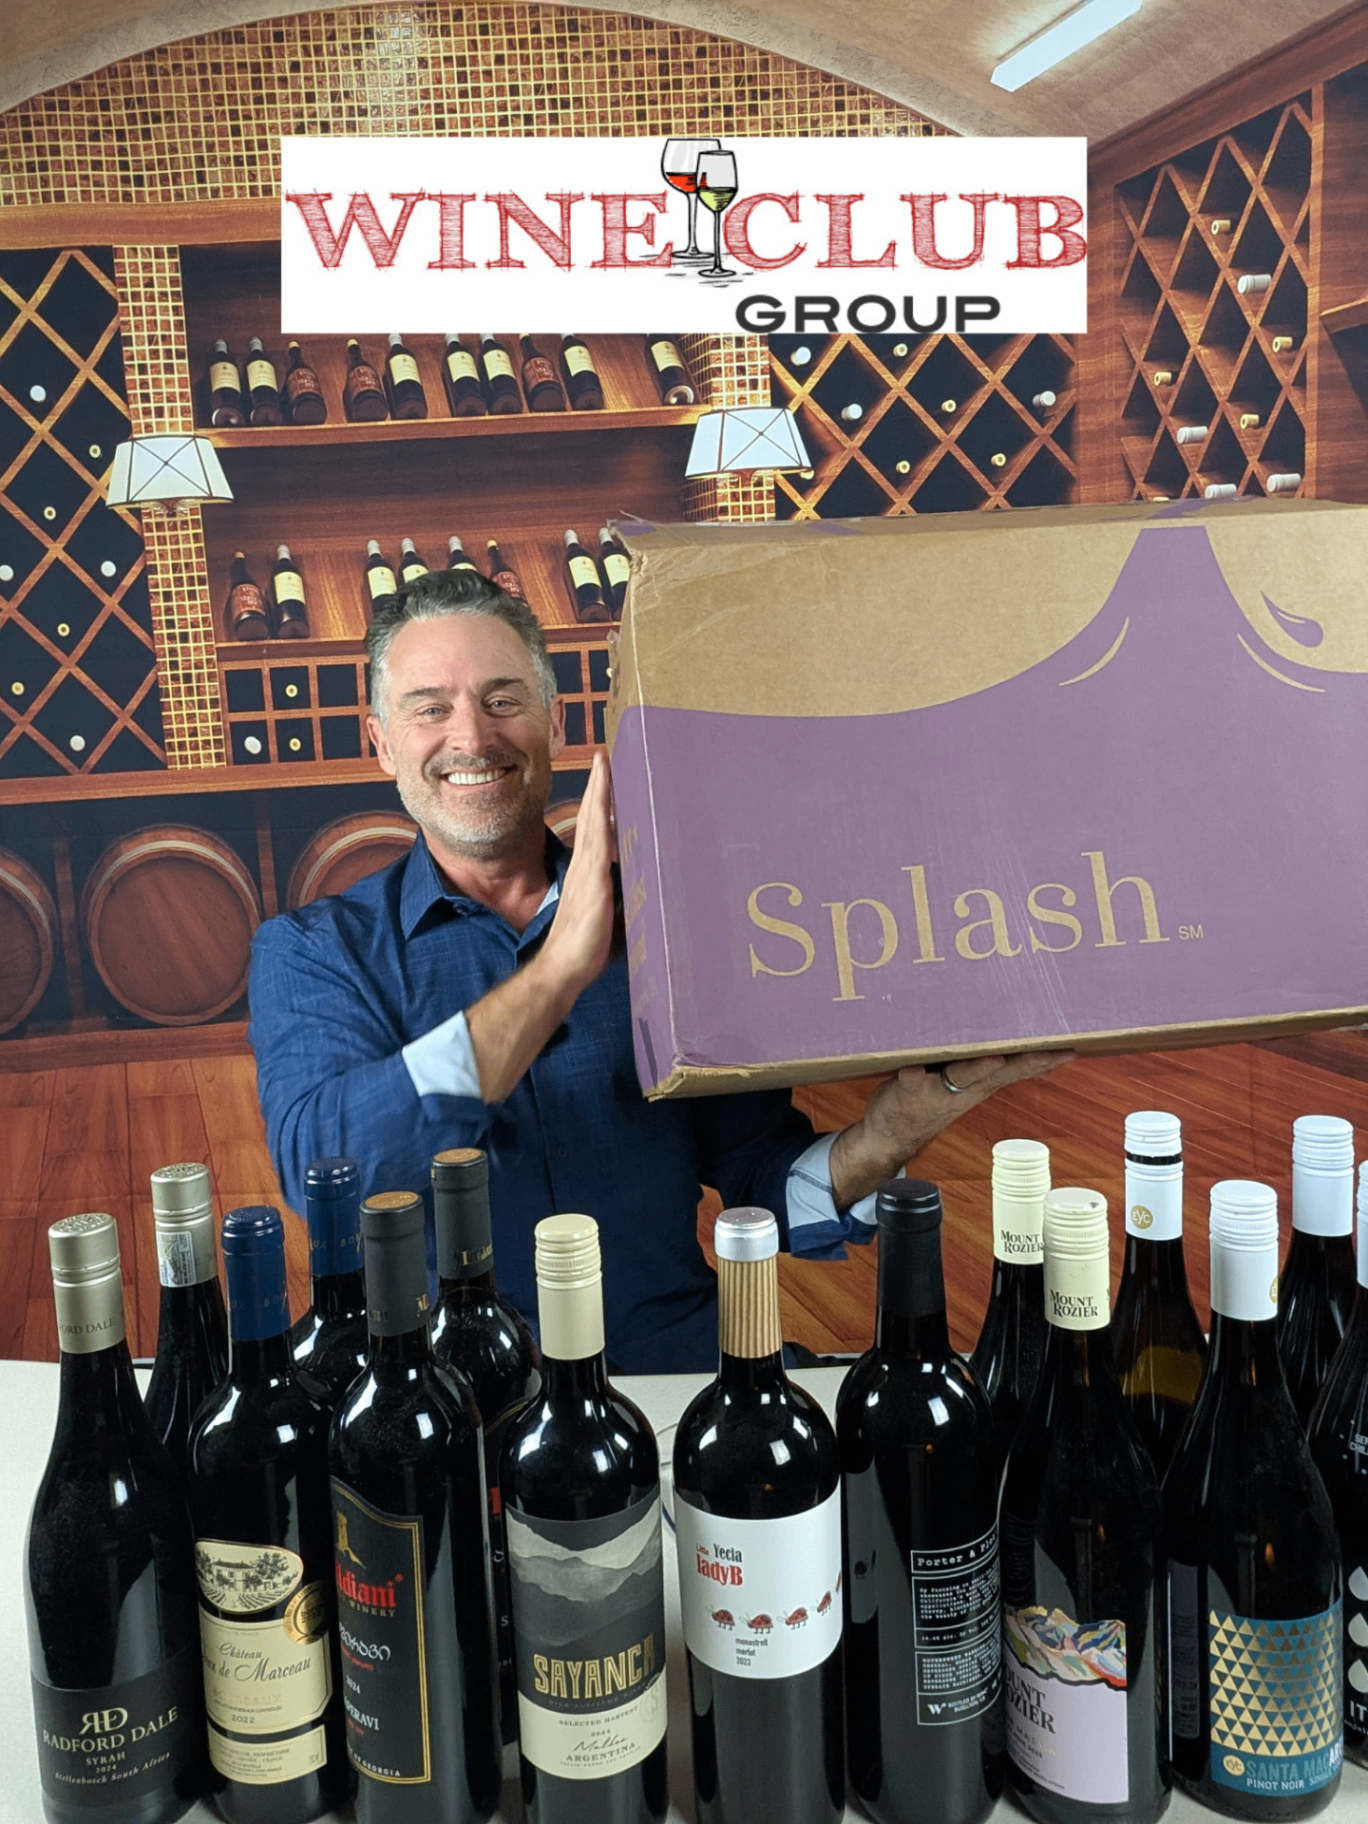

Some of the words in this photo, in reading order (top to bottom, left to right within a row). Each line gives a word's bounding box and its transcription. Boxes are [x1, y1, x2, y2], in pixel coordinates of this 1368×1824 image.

[745, 850, 1170, 1003] Splash
[1000, 1229, 1040, 1243] MOUNT
[1049, 1289, 1094, 1307] MOUNT
[1053, 1302, 1098, 1318] ROZIER
[86, 1317, 115, 1333] DALE
[713, 1543, 743, 1563] Yecla
[917, 1555, 963, 1567] Porter
[696, 1553, 743, 1586] ladyB
[349, 1600, 396, 1618] WINERY
[220, 1643, 262, 1659] Château
[735, 1648, 756, 1657] merlot
[219, 1660, 230, 1677] de
[234, 1657, 312, 1682] Marceau
[736, 1657, 751, 1667] 2023
[231, 1714, 256, 1724] 2022
[559, 1719, 601, 1727] SELECTED
[604, 1704, 638, 1724] HARVEST
[43, 1729, 125, 1753] RADFORD
[131, 1706, 179, 1743] DALE
[85, 1751, 126, 1766] SYRAH
[566, 1742, 636, 1762] ARGENTINA
[95, 1764, 117, 1774] 2024
[111, 1765, 138, 1781] South
[142, 1752, 171, 1771] Africa
[362, 1760, 400, 1777] GEORGIA
[1246, 1760, 1299, 1782] SANTA
[1246, 1778, 1279, 1791] PINOT
[1281, 1779, 1305, 1791] NOIR
